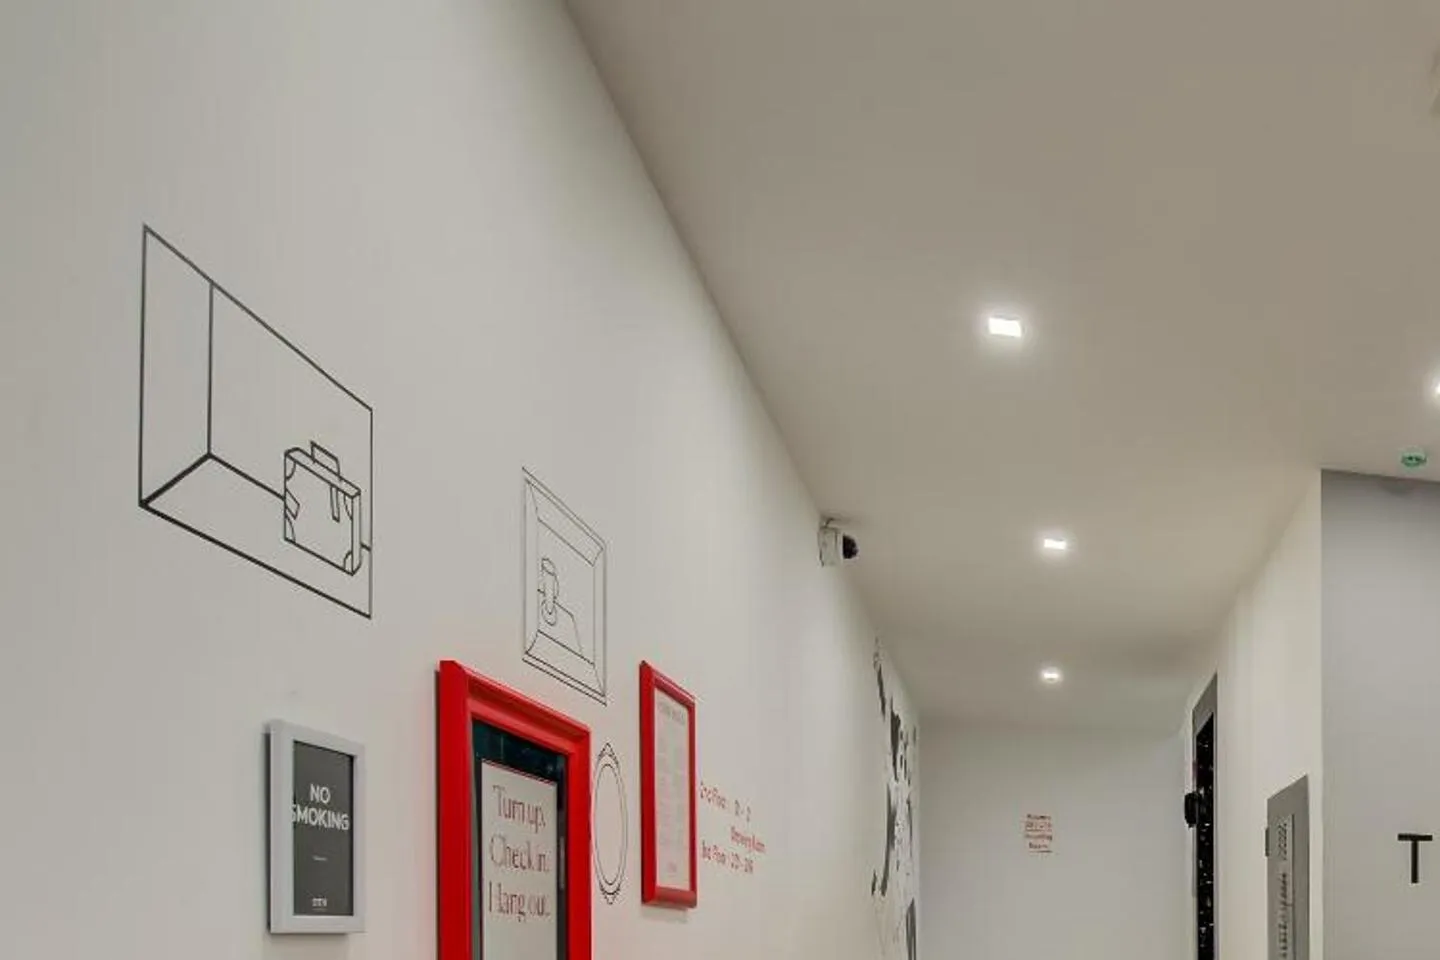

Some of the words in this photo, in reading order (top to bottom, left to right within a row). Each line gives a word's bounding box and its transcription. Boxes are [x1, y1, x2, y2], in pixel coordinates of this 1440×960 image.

[310, 783, 331, 804] NO
[493, 784, 525, 823] Turn
[292, 803, 350, 831] SMOKING
[490, 834, 534, 871] Check
[489, 881, 526, 922] Hang
